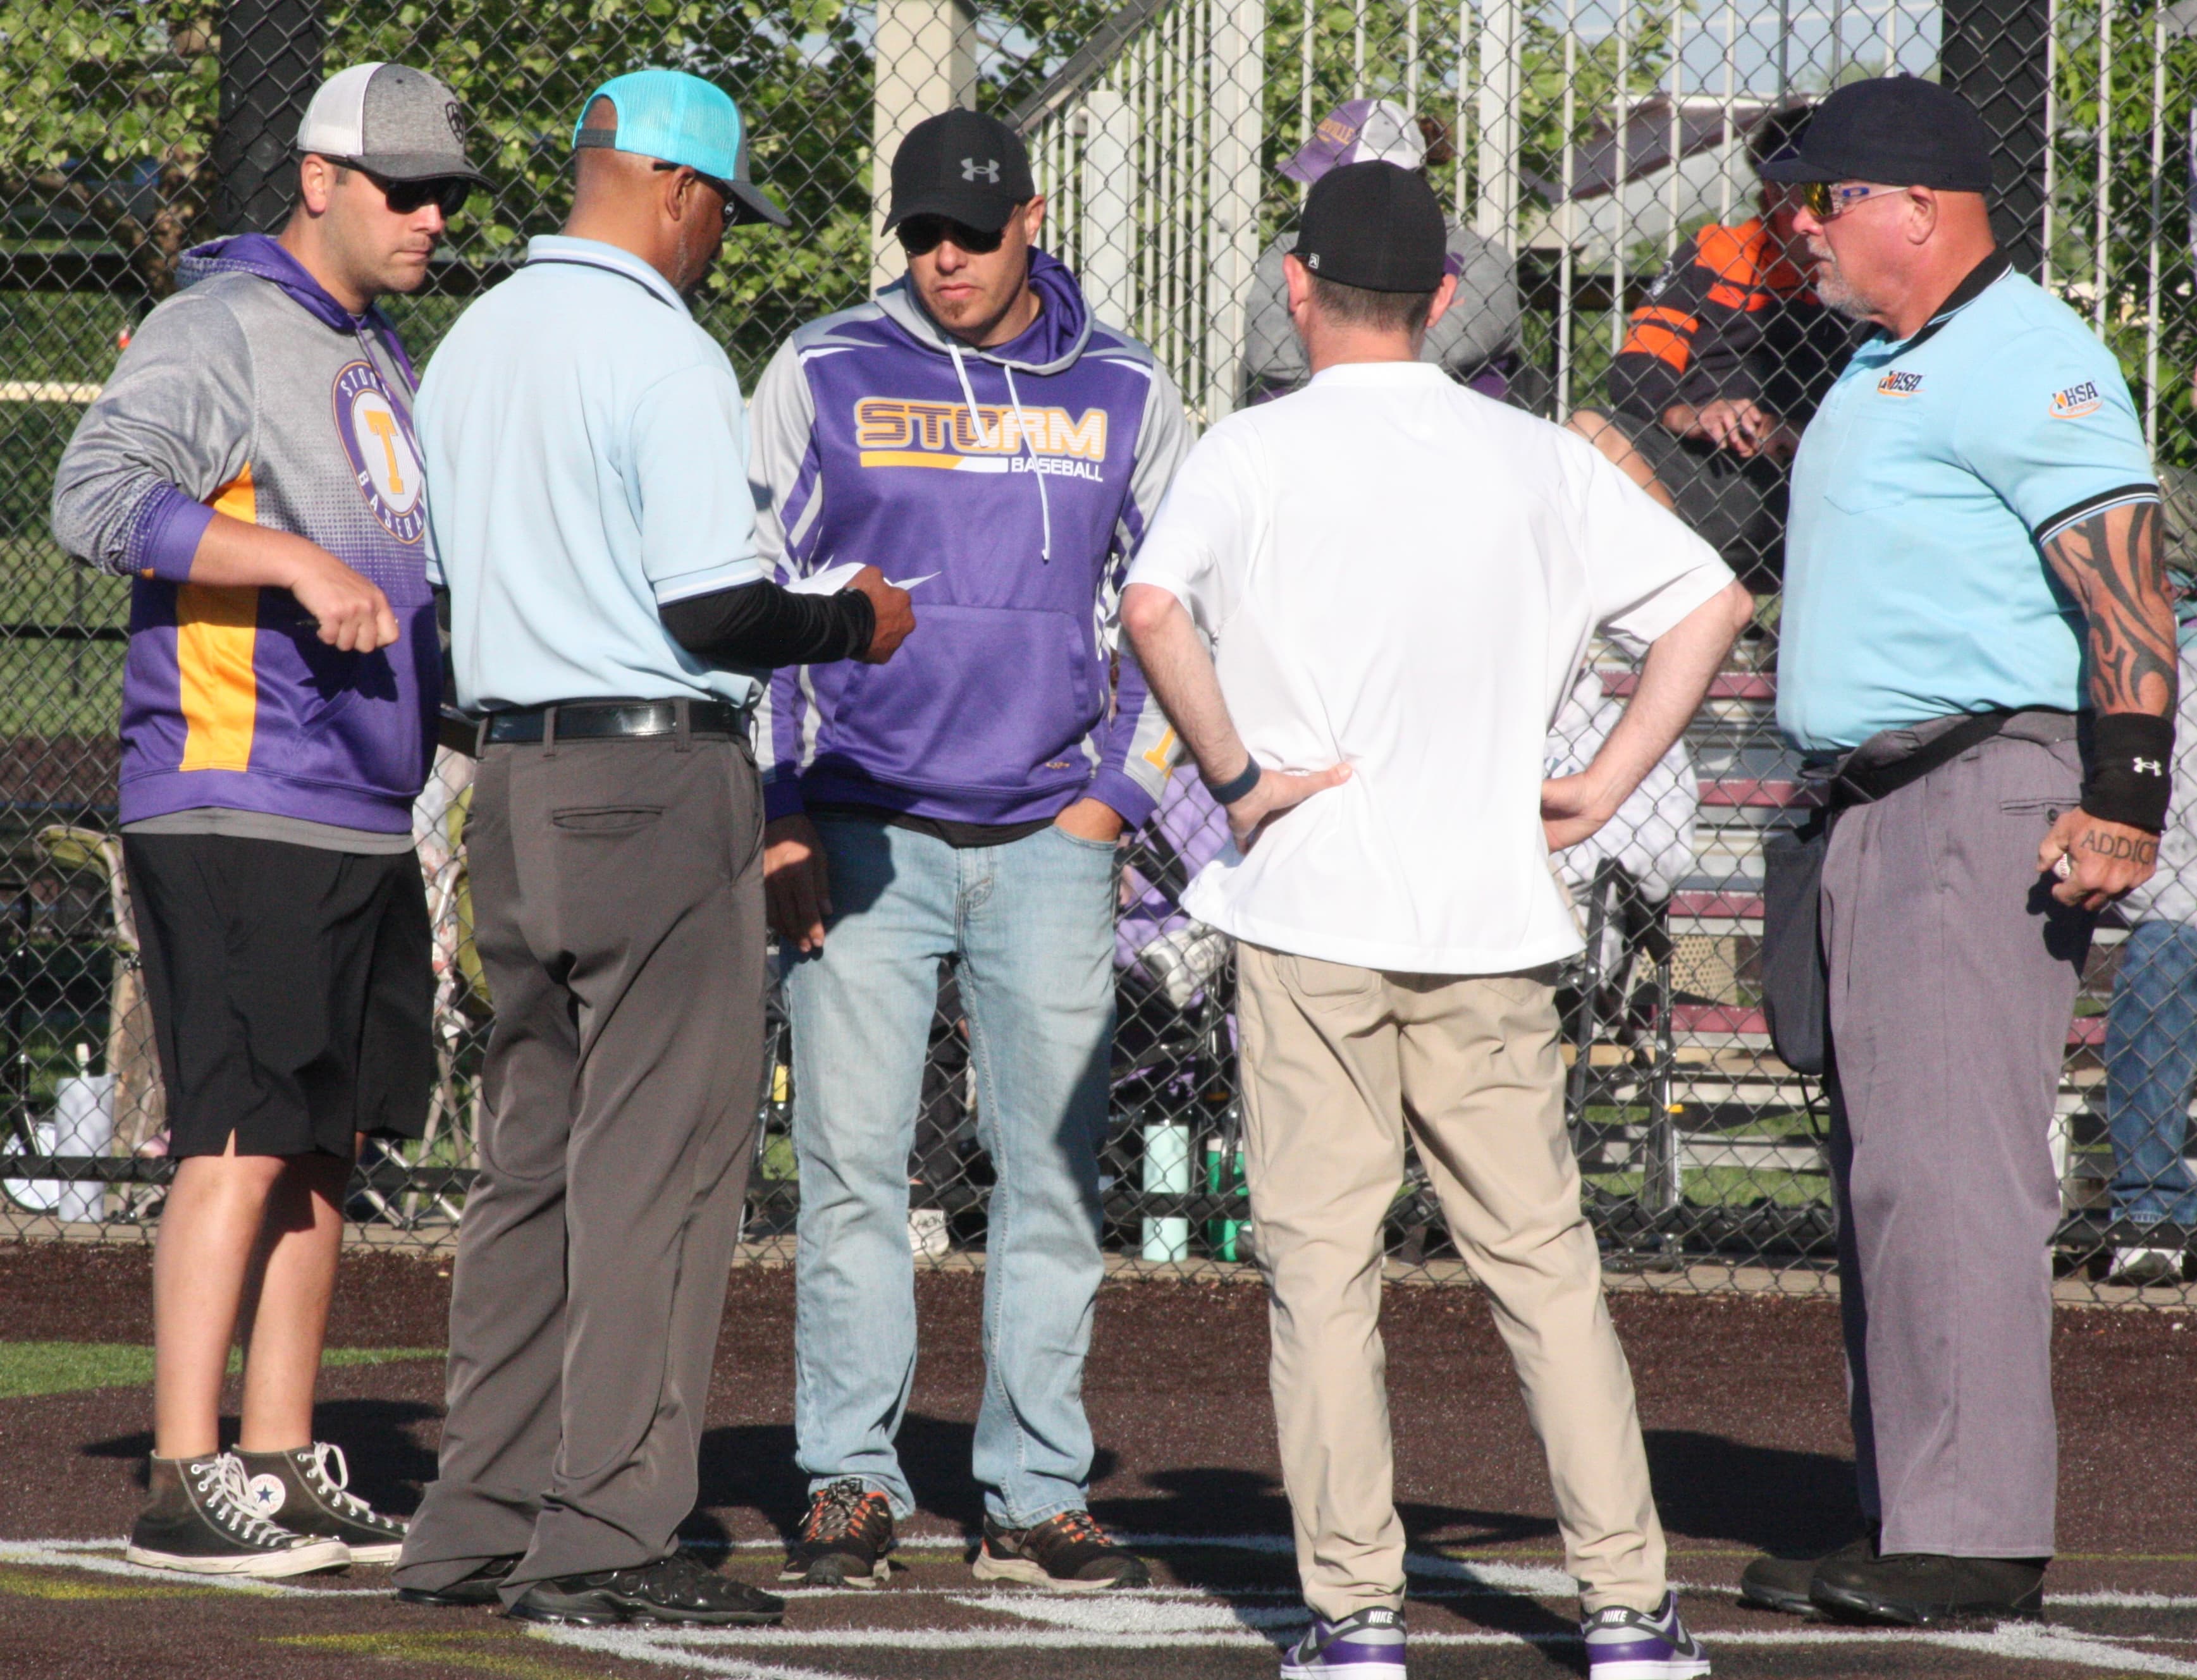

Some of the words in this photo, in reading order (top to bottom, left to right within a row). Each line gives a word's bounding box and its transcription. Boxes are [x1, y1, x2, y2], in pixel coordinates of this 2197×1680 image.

[363, 409, 403, 494] T
[854, 397, 1108, 463] STORM
[1011, 457, 1104, 483] BASEBALL
[358, 470, 425, 539] BASEBA
[1368, 1610, 1394, 1624] NIKE
[1601, 1610, 1628, 1623] NIKE
